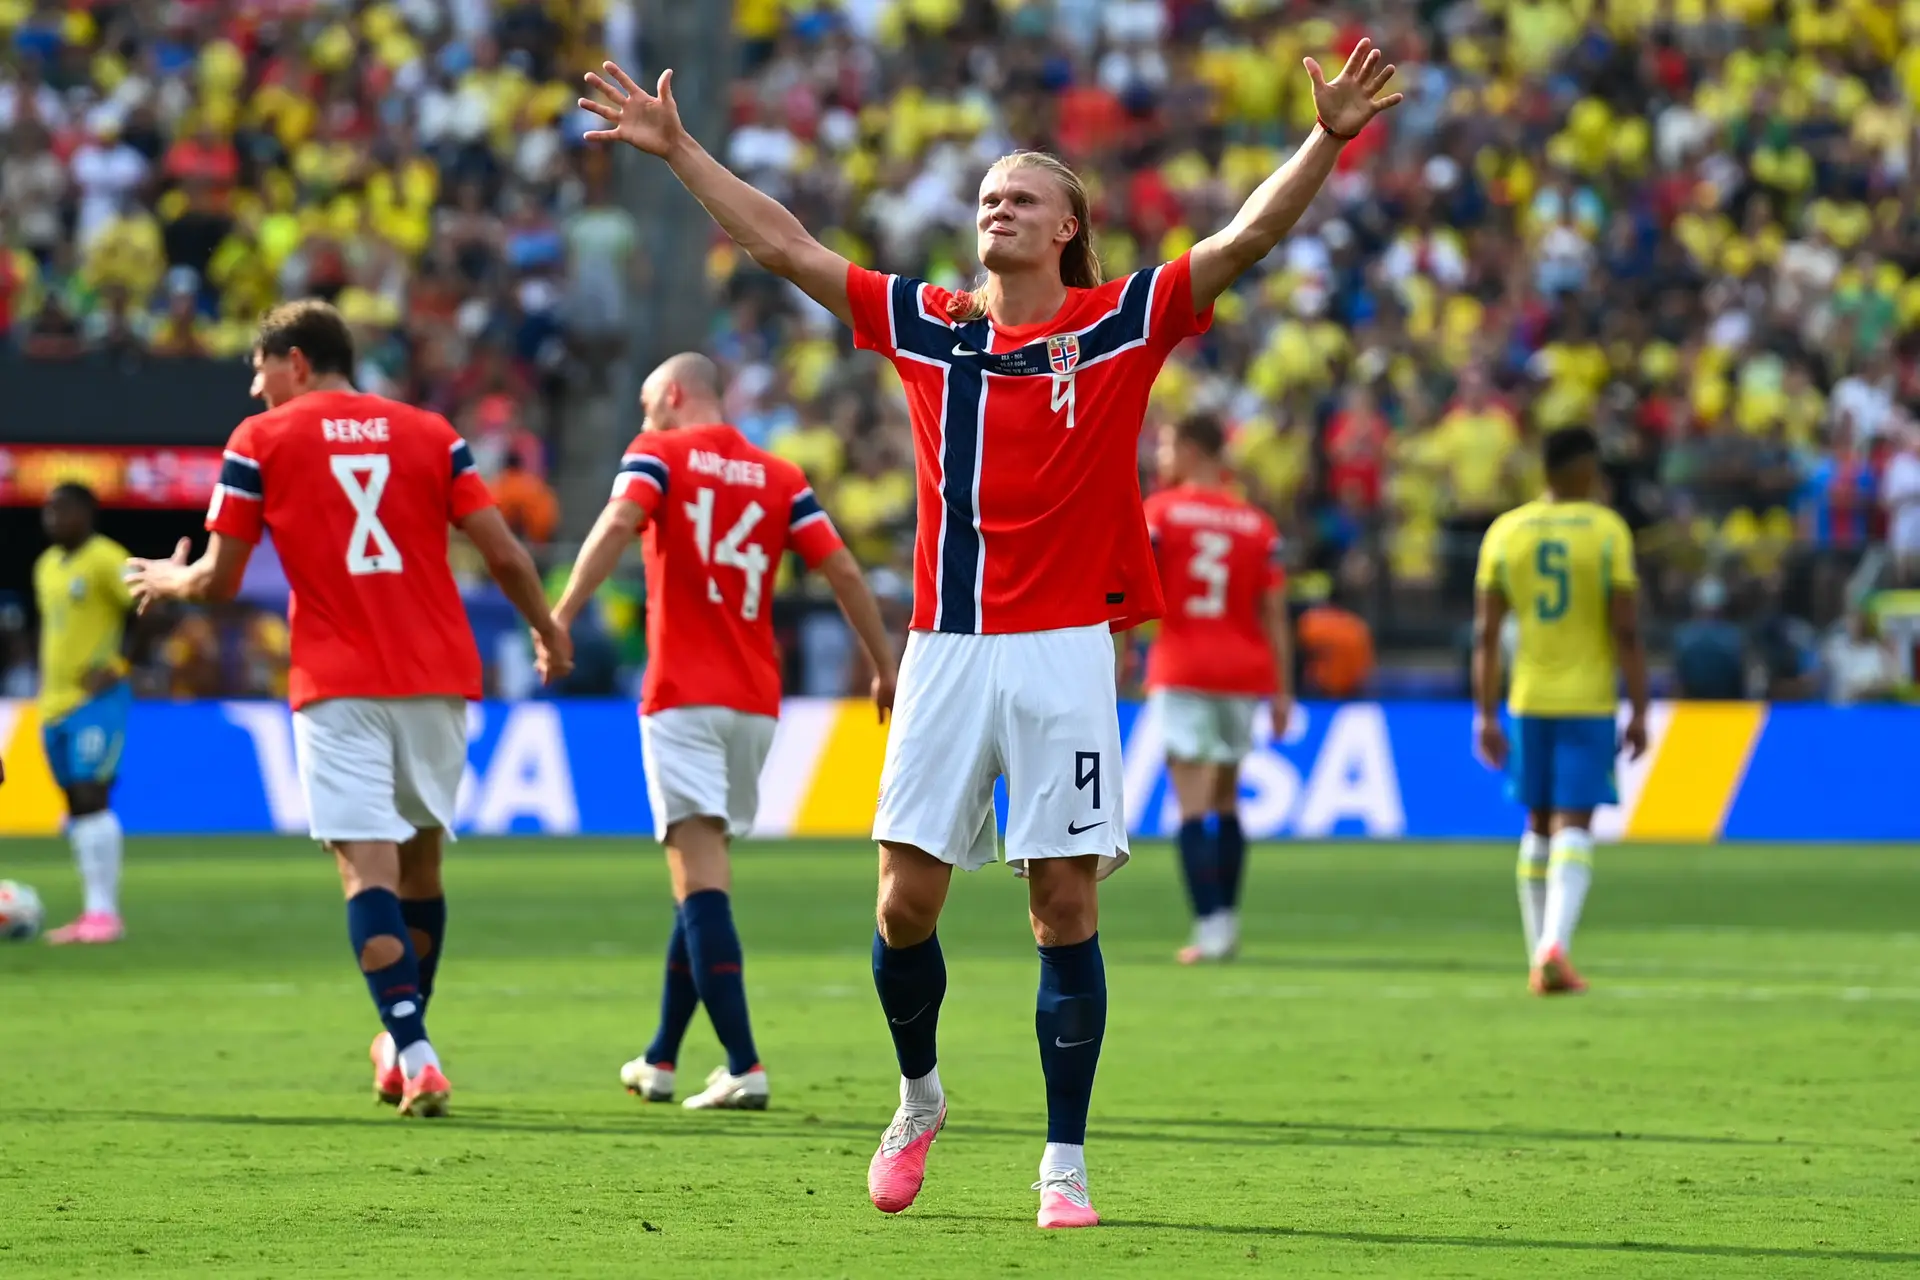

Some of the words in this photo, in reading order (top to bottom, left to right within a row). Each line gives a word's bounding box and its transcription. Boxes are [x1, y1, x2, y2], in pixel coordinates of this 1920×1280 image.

[321, 417, 390, 443] BERGE
[1051, 373, 1075, 428] 9
[329, 453, 403, 575] 8
[684, 487, 770, 621] 14
[1185, 530, 1232, 618] 3
[1535, 539, 1569, 622] 5
[222, 702, 580, 834] VA
[1075, 751, 1100, 809] 9
[1118, 702, 1406, 836] SA
